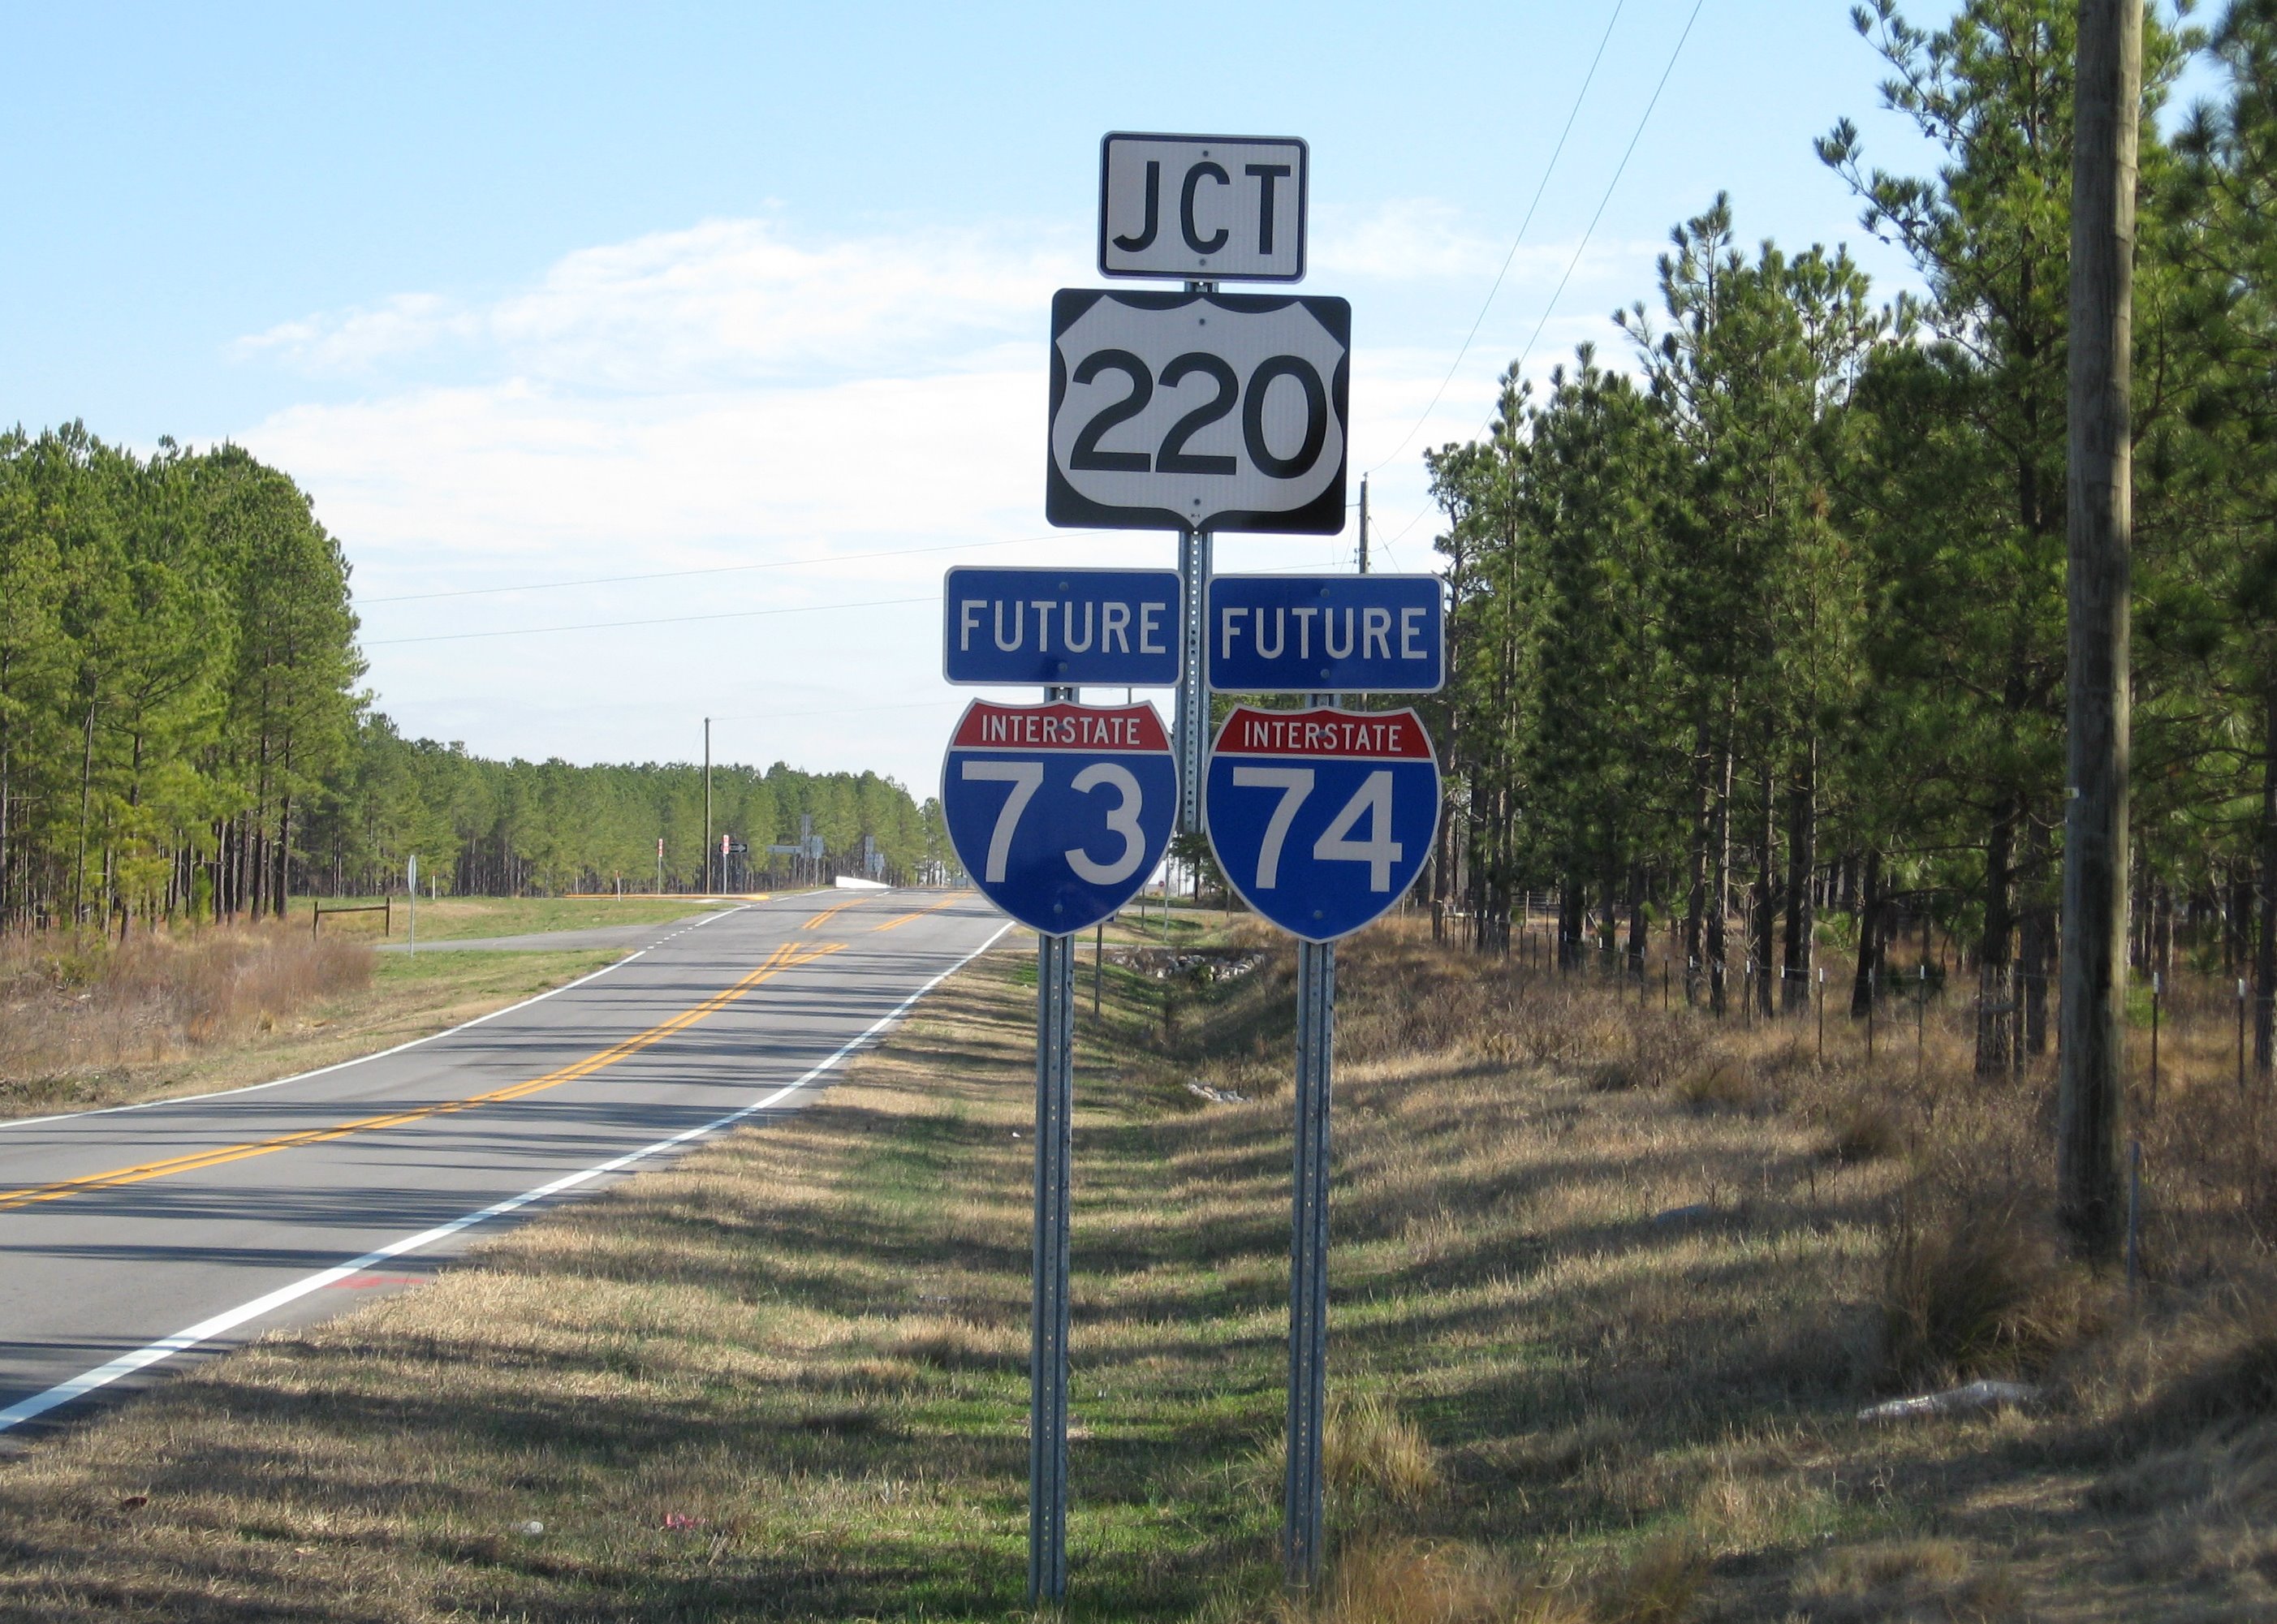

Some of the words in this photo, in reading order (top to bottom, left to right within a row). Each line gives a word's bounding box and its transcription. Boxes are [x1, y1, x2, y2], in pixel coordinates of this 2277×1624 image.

[1111, 160, 1292, 256] JCT
[1069, 348, 1328, 480] 220
[960, 599, 1167, 654] FUTURE
[1222, 607, 1428, 660] FUTURE
[981, 714, 1141, 745] INTERSTATE
[1244, 721, 1403, 752] INTERSTATE
[961, 760, 1146, 885] 73
[1232, 766, 1403, 892] 74
